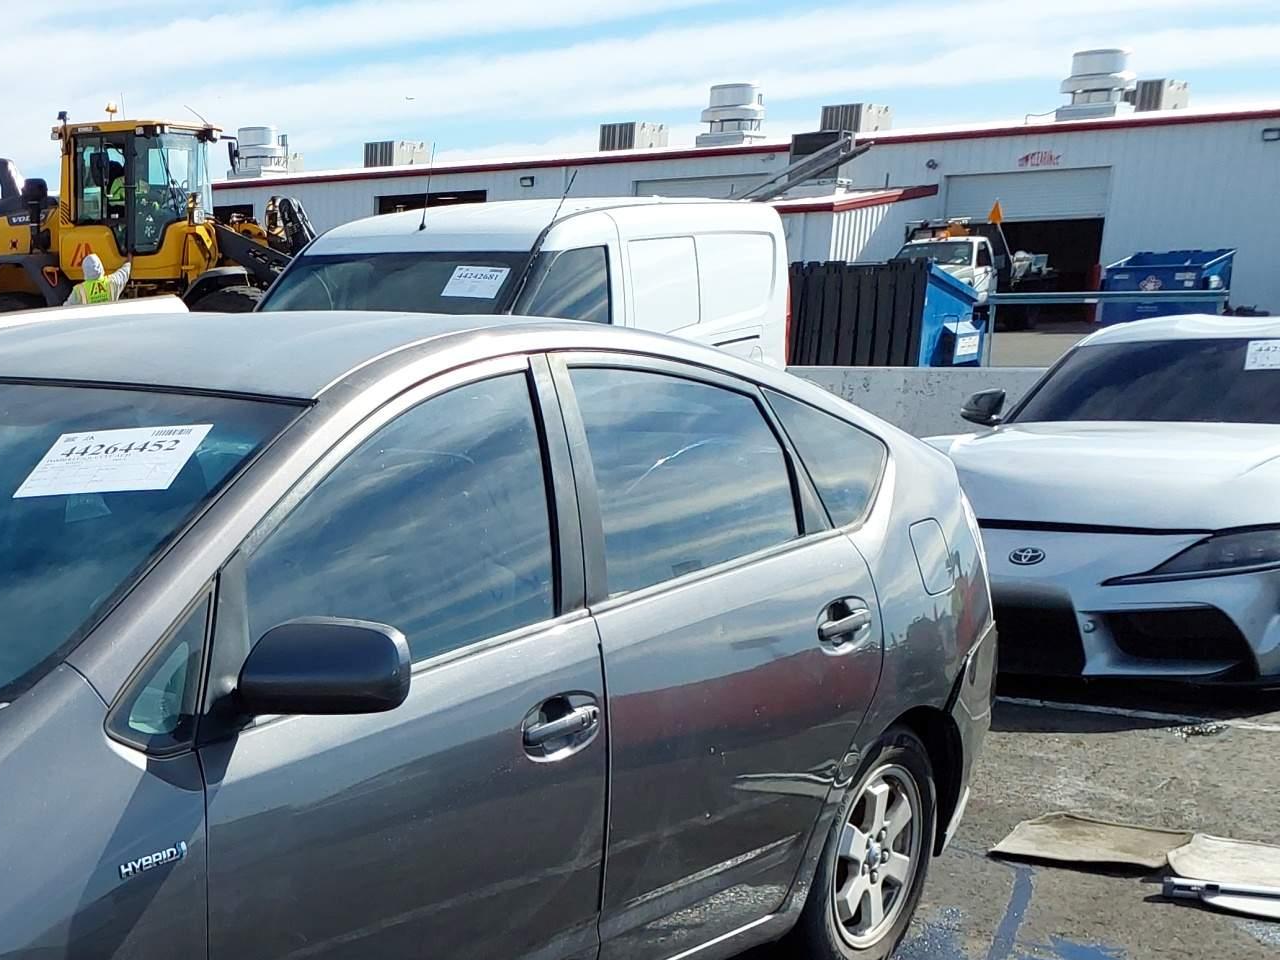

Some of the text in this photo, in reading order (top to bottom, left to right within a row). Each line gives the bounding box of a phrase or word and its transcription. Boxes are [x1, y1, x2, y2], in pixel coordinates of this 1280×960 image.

[457, 272, 499, 281] 44242681
[61, 439, 180, 457] 44264452
[119, 847, 179, 879] HYBRID
